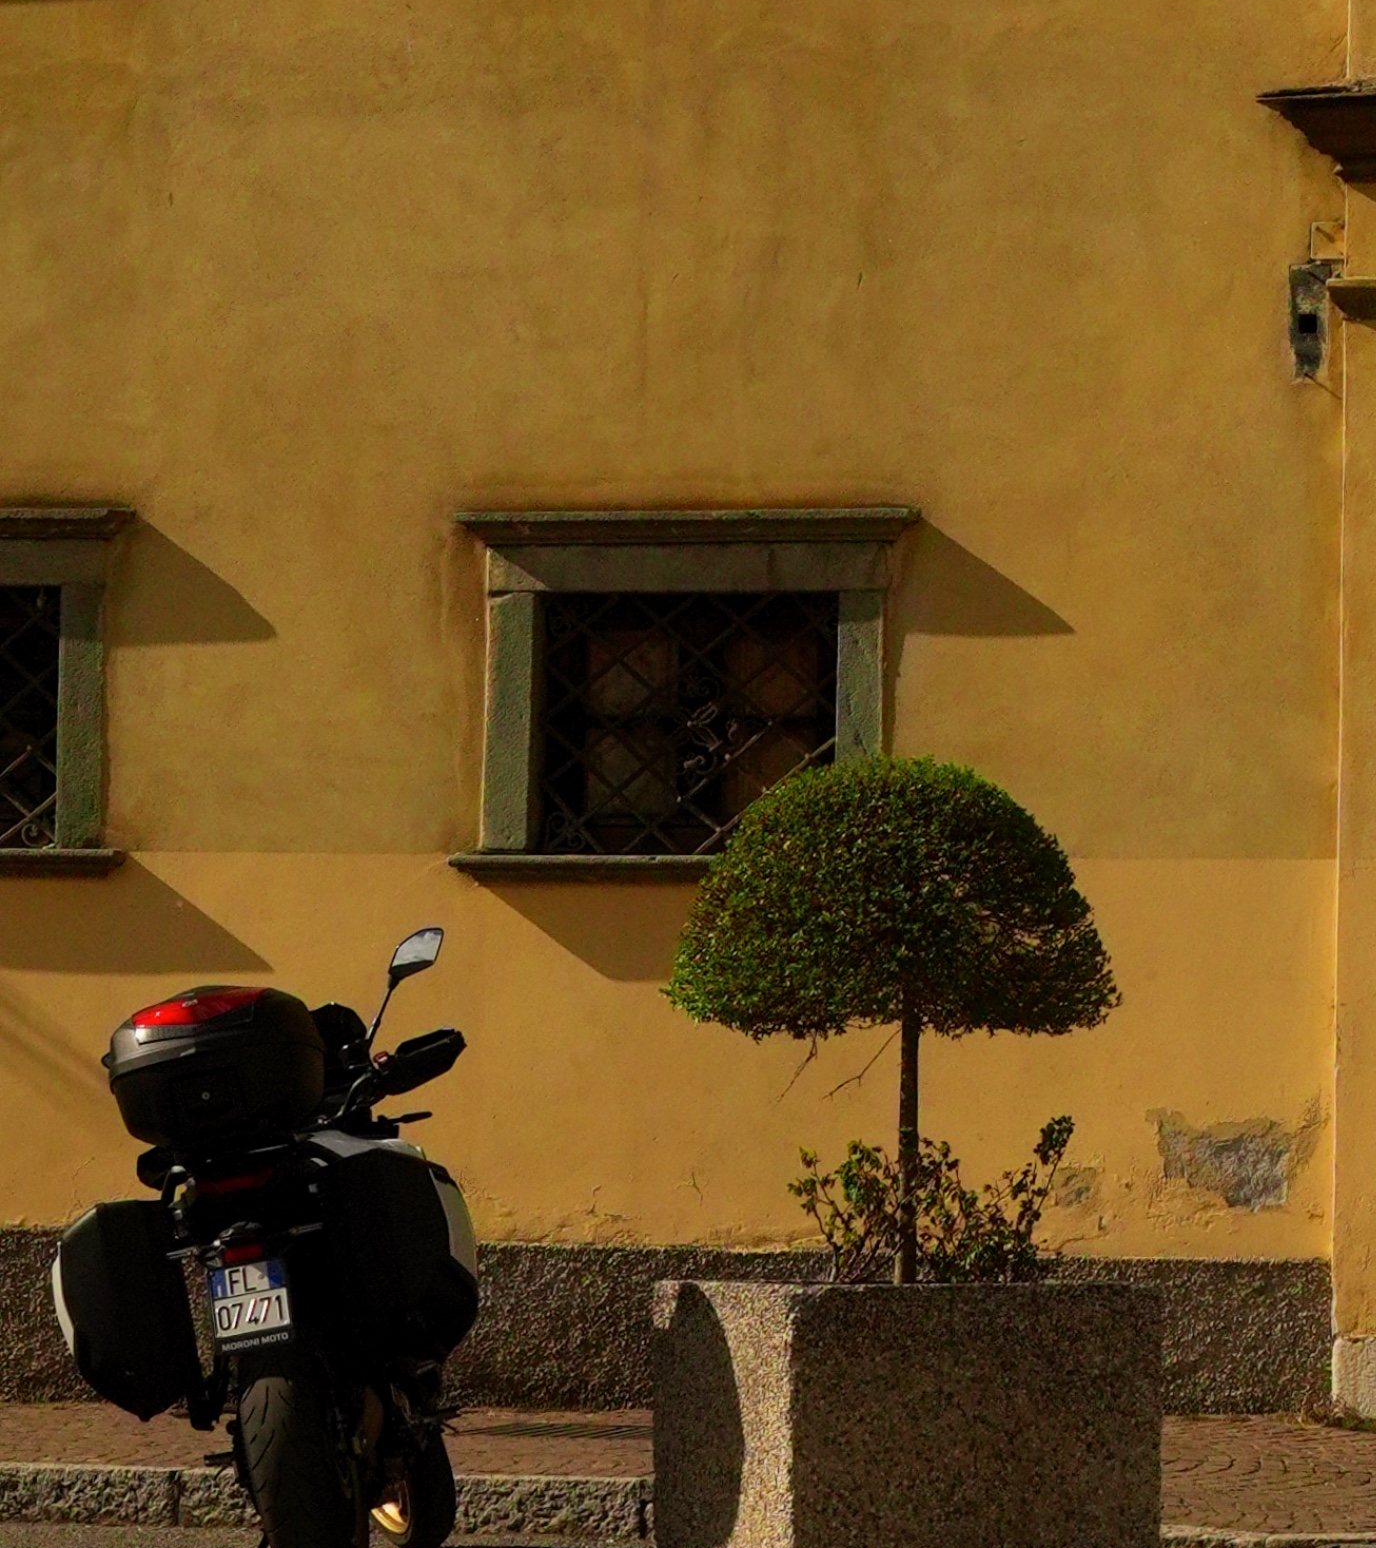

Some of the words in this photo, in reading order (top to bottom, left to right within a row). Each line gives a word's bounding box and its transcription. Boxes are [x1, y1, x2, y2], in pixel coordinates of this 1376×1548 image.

[228, 1267, 257, 1295] FL
[217, 1294, 284, 1331] 07471
[221, 1337, 260, 1353] MORONI
[261, 1331, 289, 1345] MOTO
